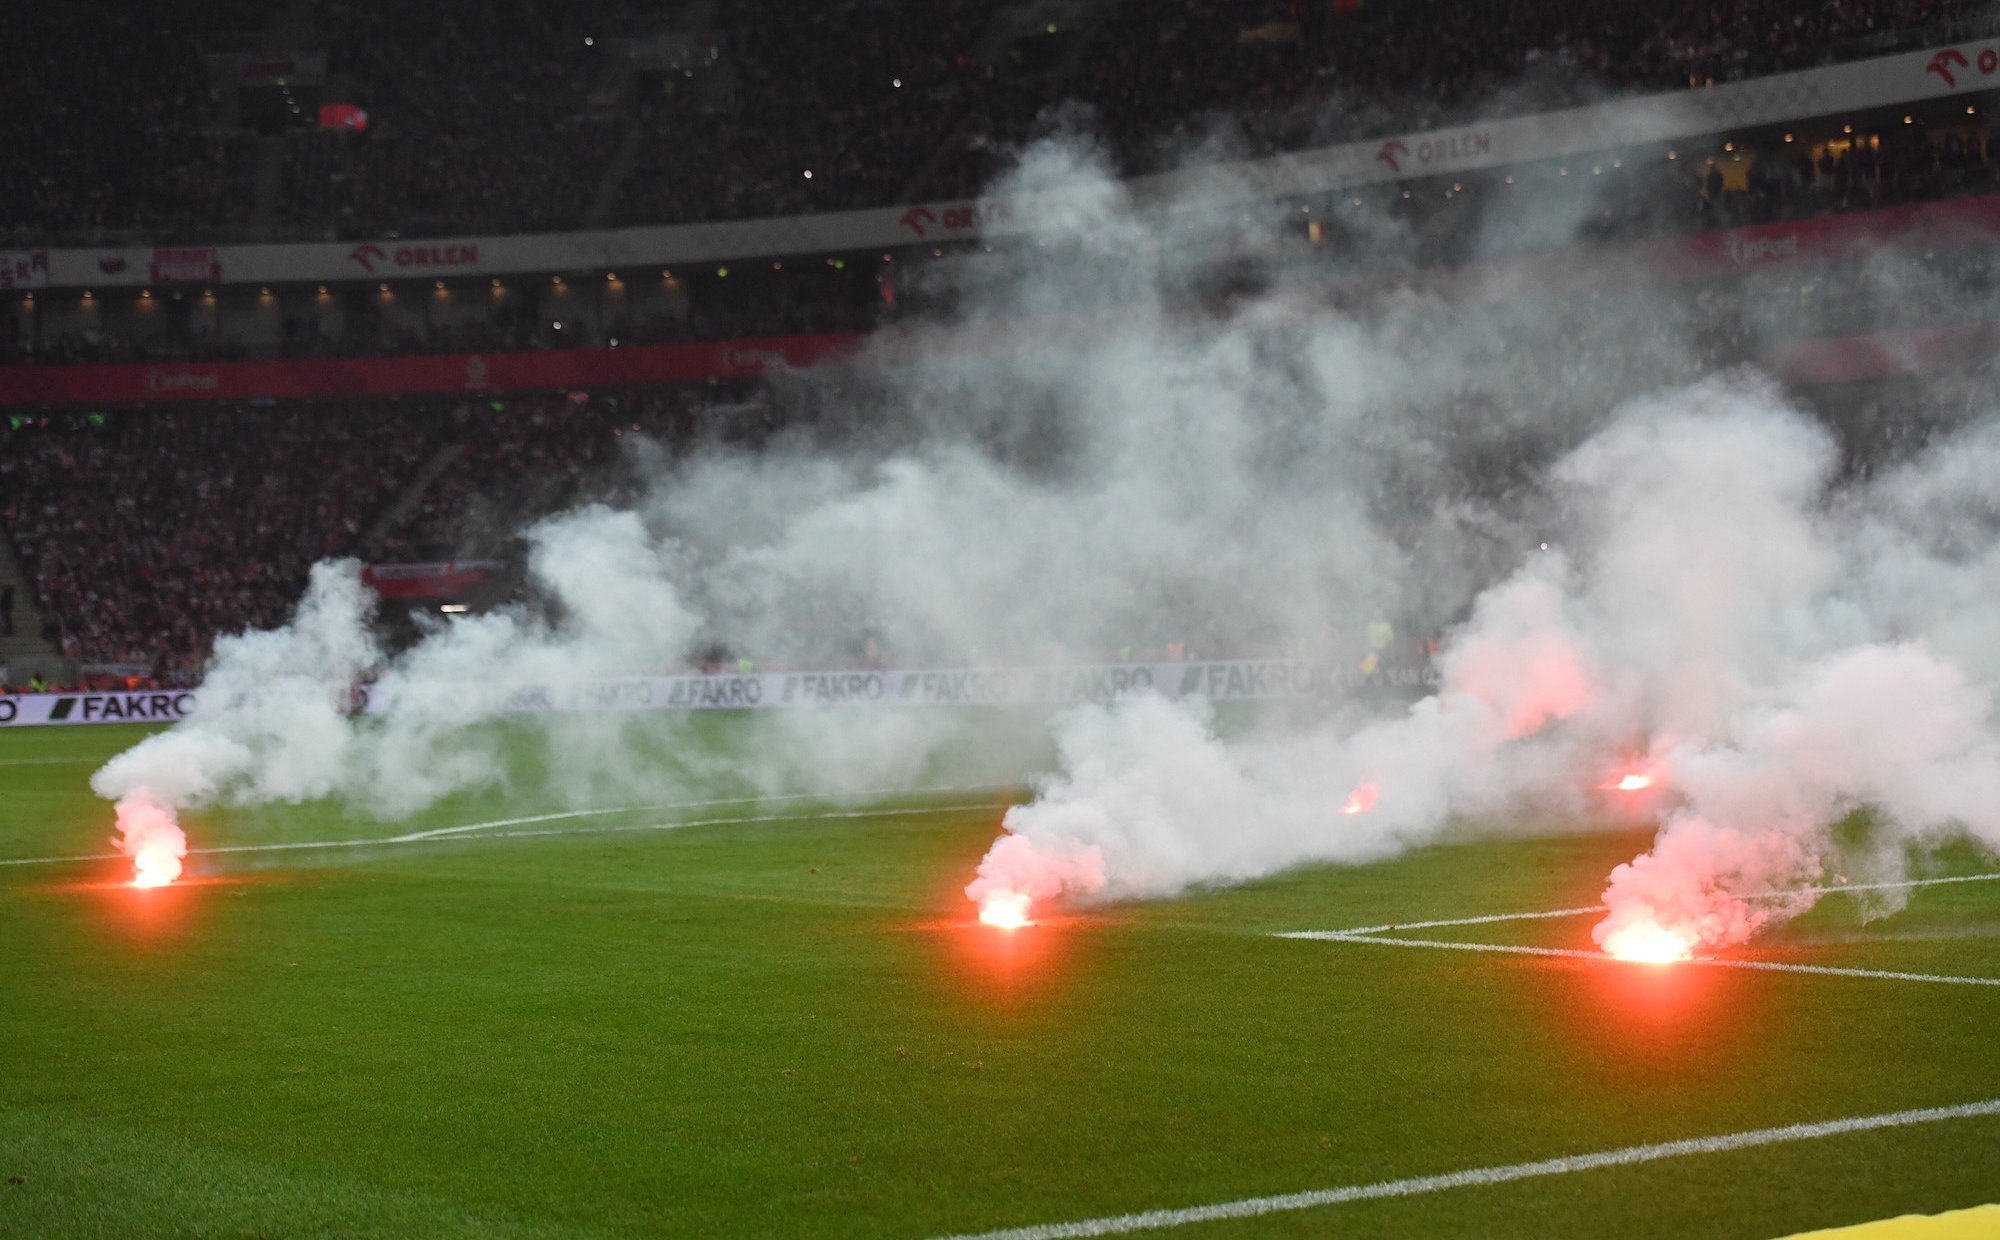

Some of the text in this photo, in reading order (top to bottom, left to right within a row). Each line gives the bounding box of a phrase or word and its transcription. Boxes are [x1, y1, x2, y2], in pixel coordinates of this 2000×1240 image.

[1418, 133, 1489, 165] ORLEN
[393, 244, 478, 267] ORLEN
[688, 677, 762, 705] FAKRO
[803, 673, 884, 702] FAKRO
[924, 672, 1009, 703] FAKRO
[1208, 663, 1313, 697] FAKRO
[83, 694, 196, 720] FAKRO
